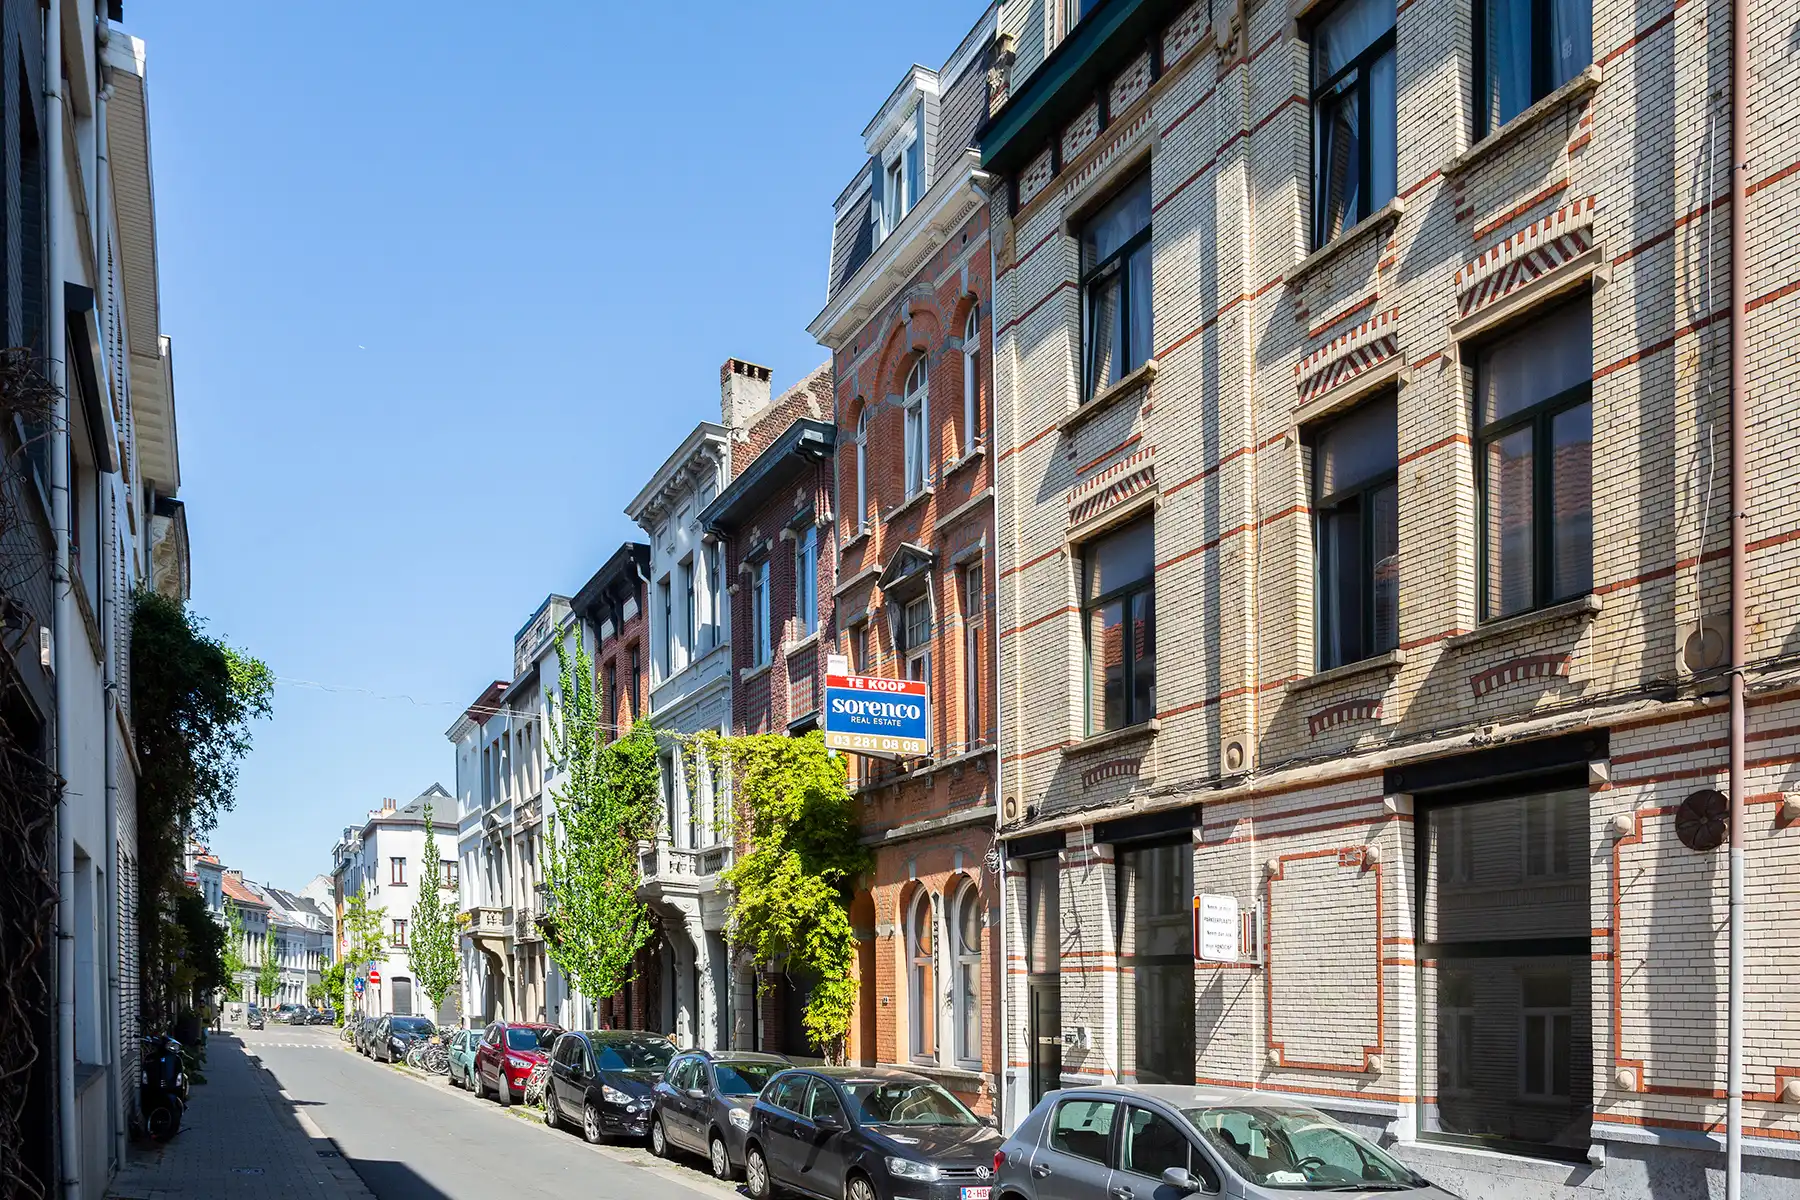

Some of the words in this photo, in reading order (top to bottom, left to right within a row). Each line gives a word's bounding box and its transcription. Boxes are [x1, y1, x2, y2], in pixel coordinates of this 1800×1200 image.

[846, 677, 864, 689] TE
[868, 679, 906, 692] KOOP
[832, 698, 920, 719] sorenco
[851, 716, 871, 725] REAL
[873, 717, 901, 726] ESTATE
[833, 735, 852, 746] 03
[854, 736, 878, 749] 281
[882, 738, 899, 750] 08
[902, 740, 920, 752] 08
